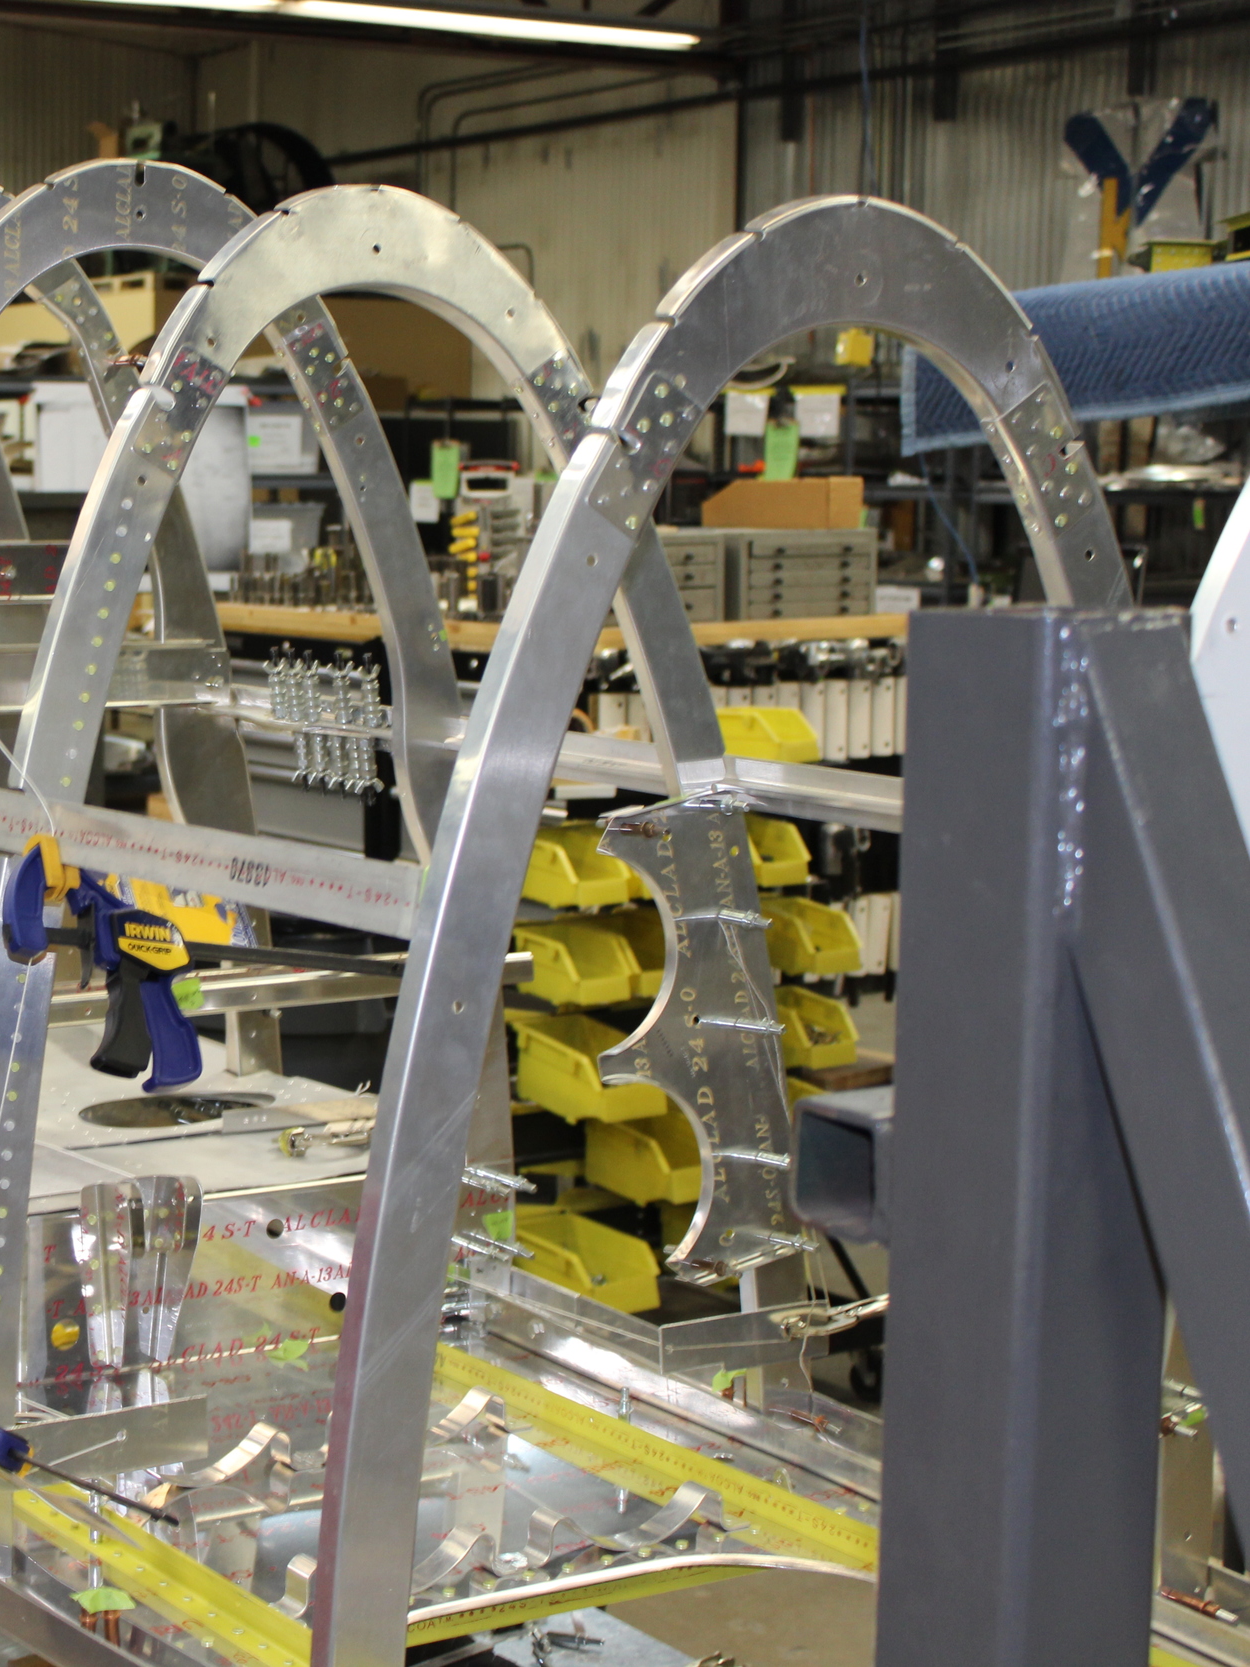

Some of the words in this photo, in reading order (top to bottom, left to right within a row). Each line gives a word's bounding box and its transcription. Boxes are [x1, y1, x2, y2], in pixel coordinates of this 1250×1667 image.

[124, 922, 171, 942] IRWIN
[282, 1206, 361, 1233] ALCLA
[213, 1275, 262, 1297] 24S-T
